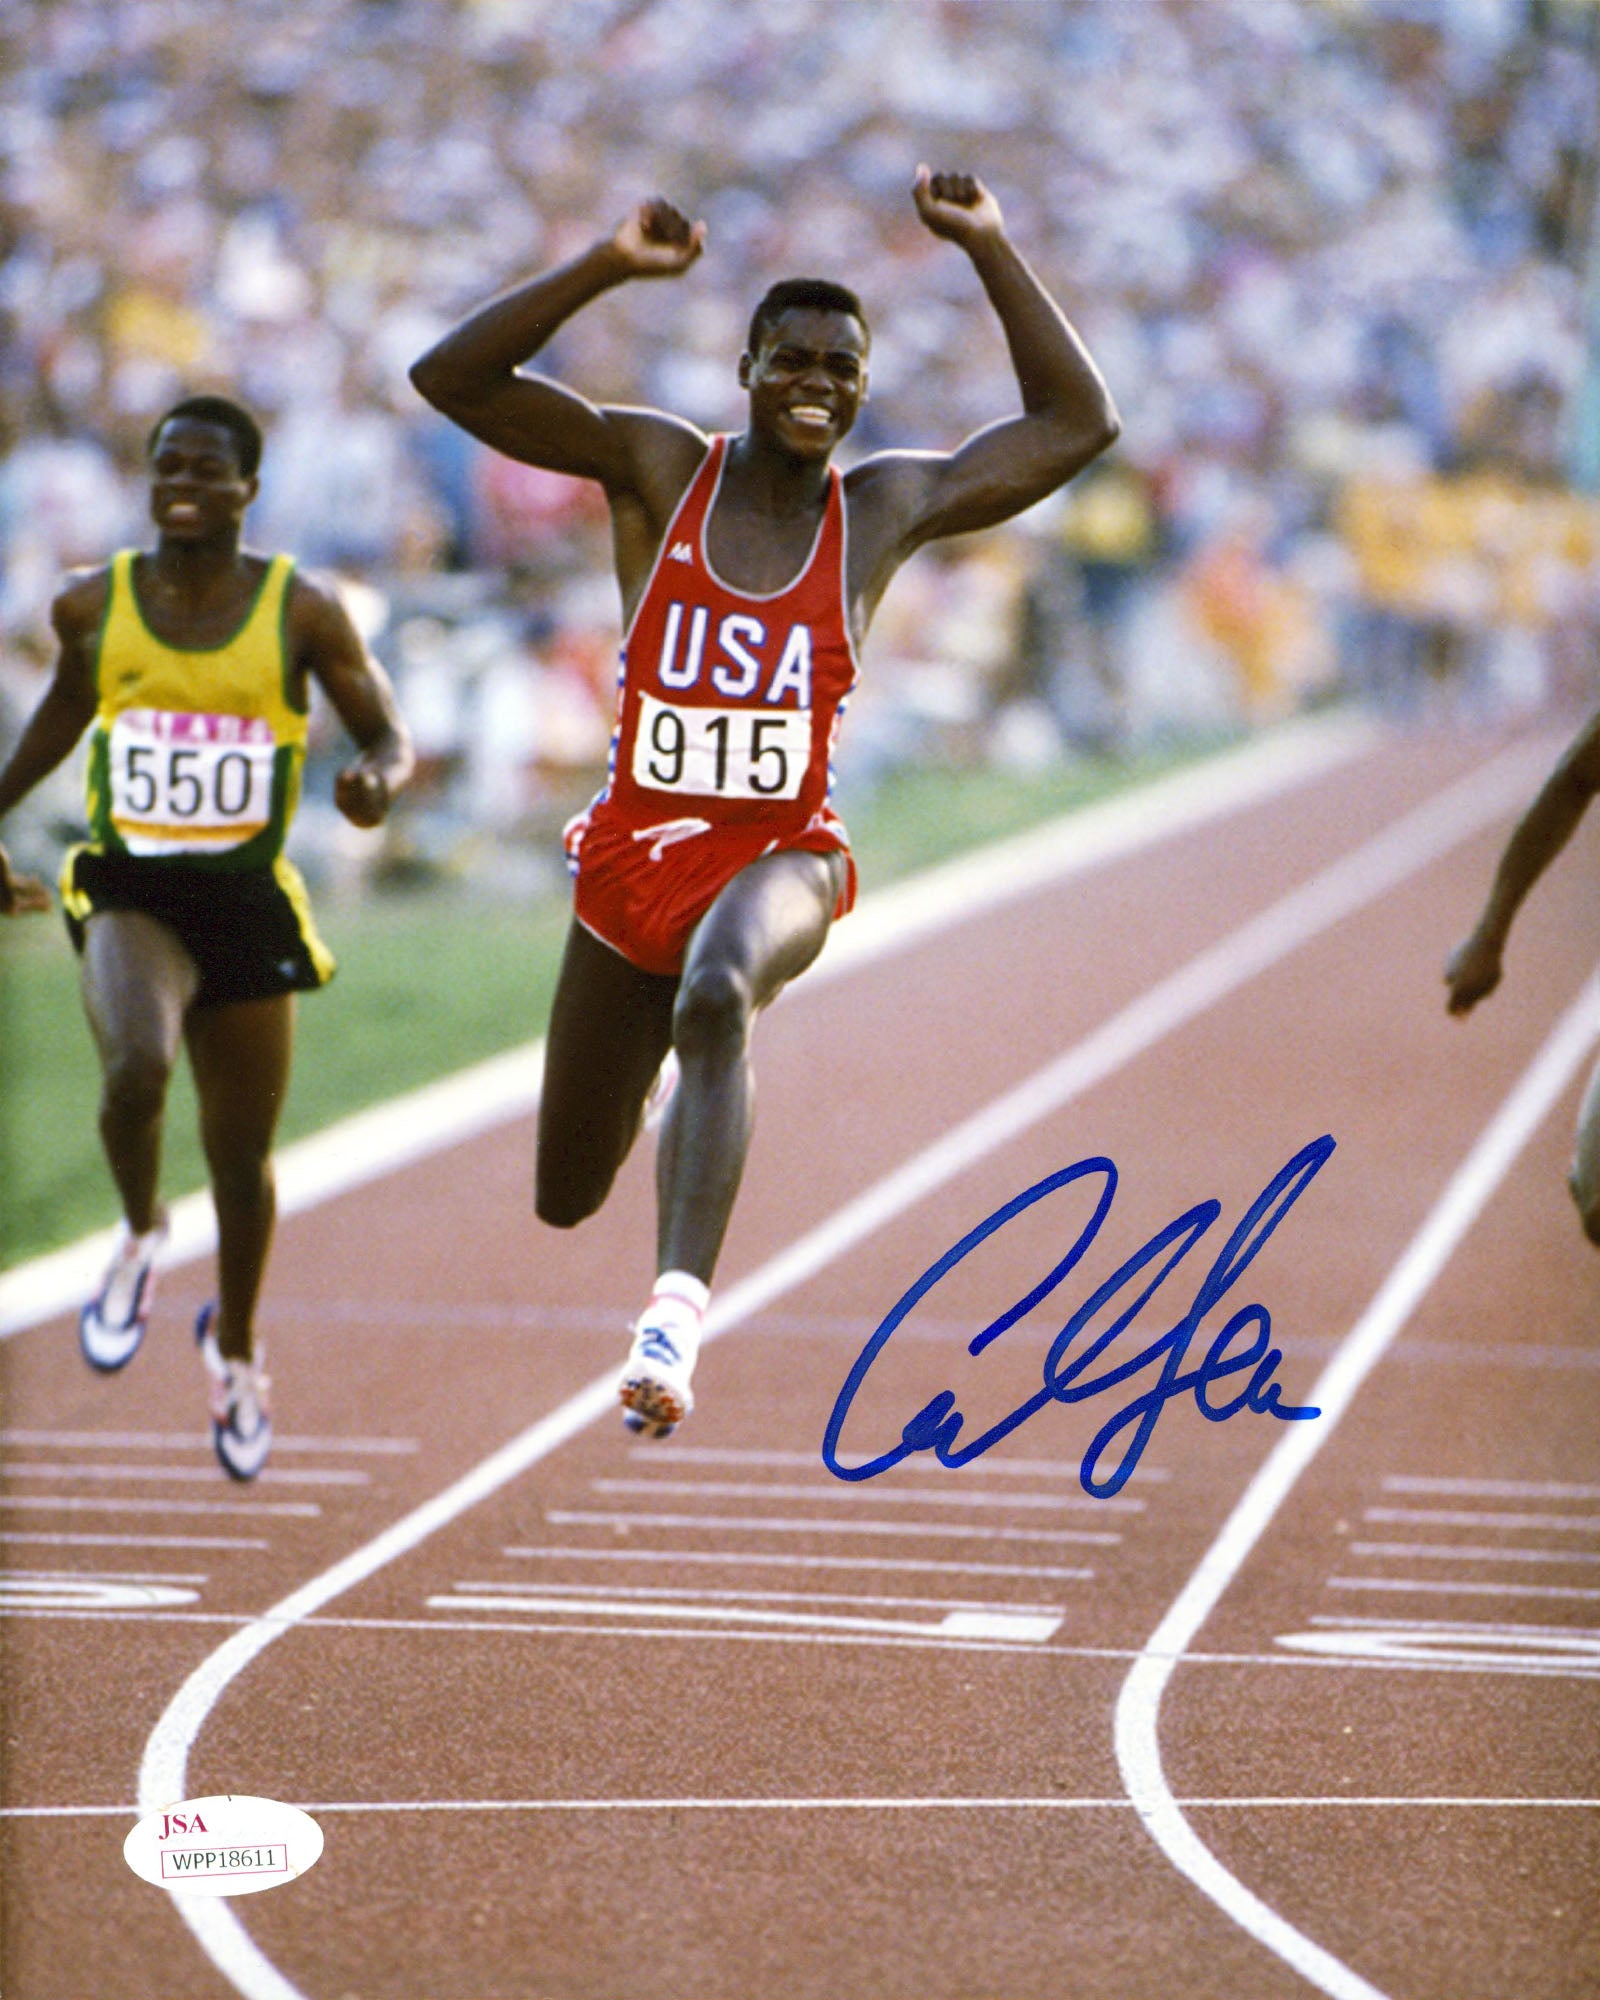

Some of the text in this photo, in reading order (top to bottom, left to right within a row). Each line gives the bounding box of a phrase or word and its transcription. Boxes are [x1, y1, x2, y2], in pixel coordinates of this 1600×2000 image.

[658, 602, 812, 710] USA
[126, 744, 252, 817] 550
[648, 709, 788, 795] 915
[158, 1813, 209, 1840] JSA
[172, 1848, 276, 1871] WPP18611
